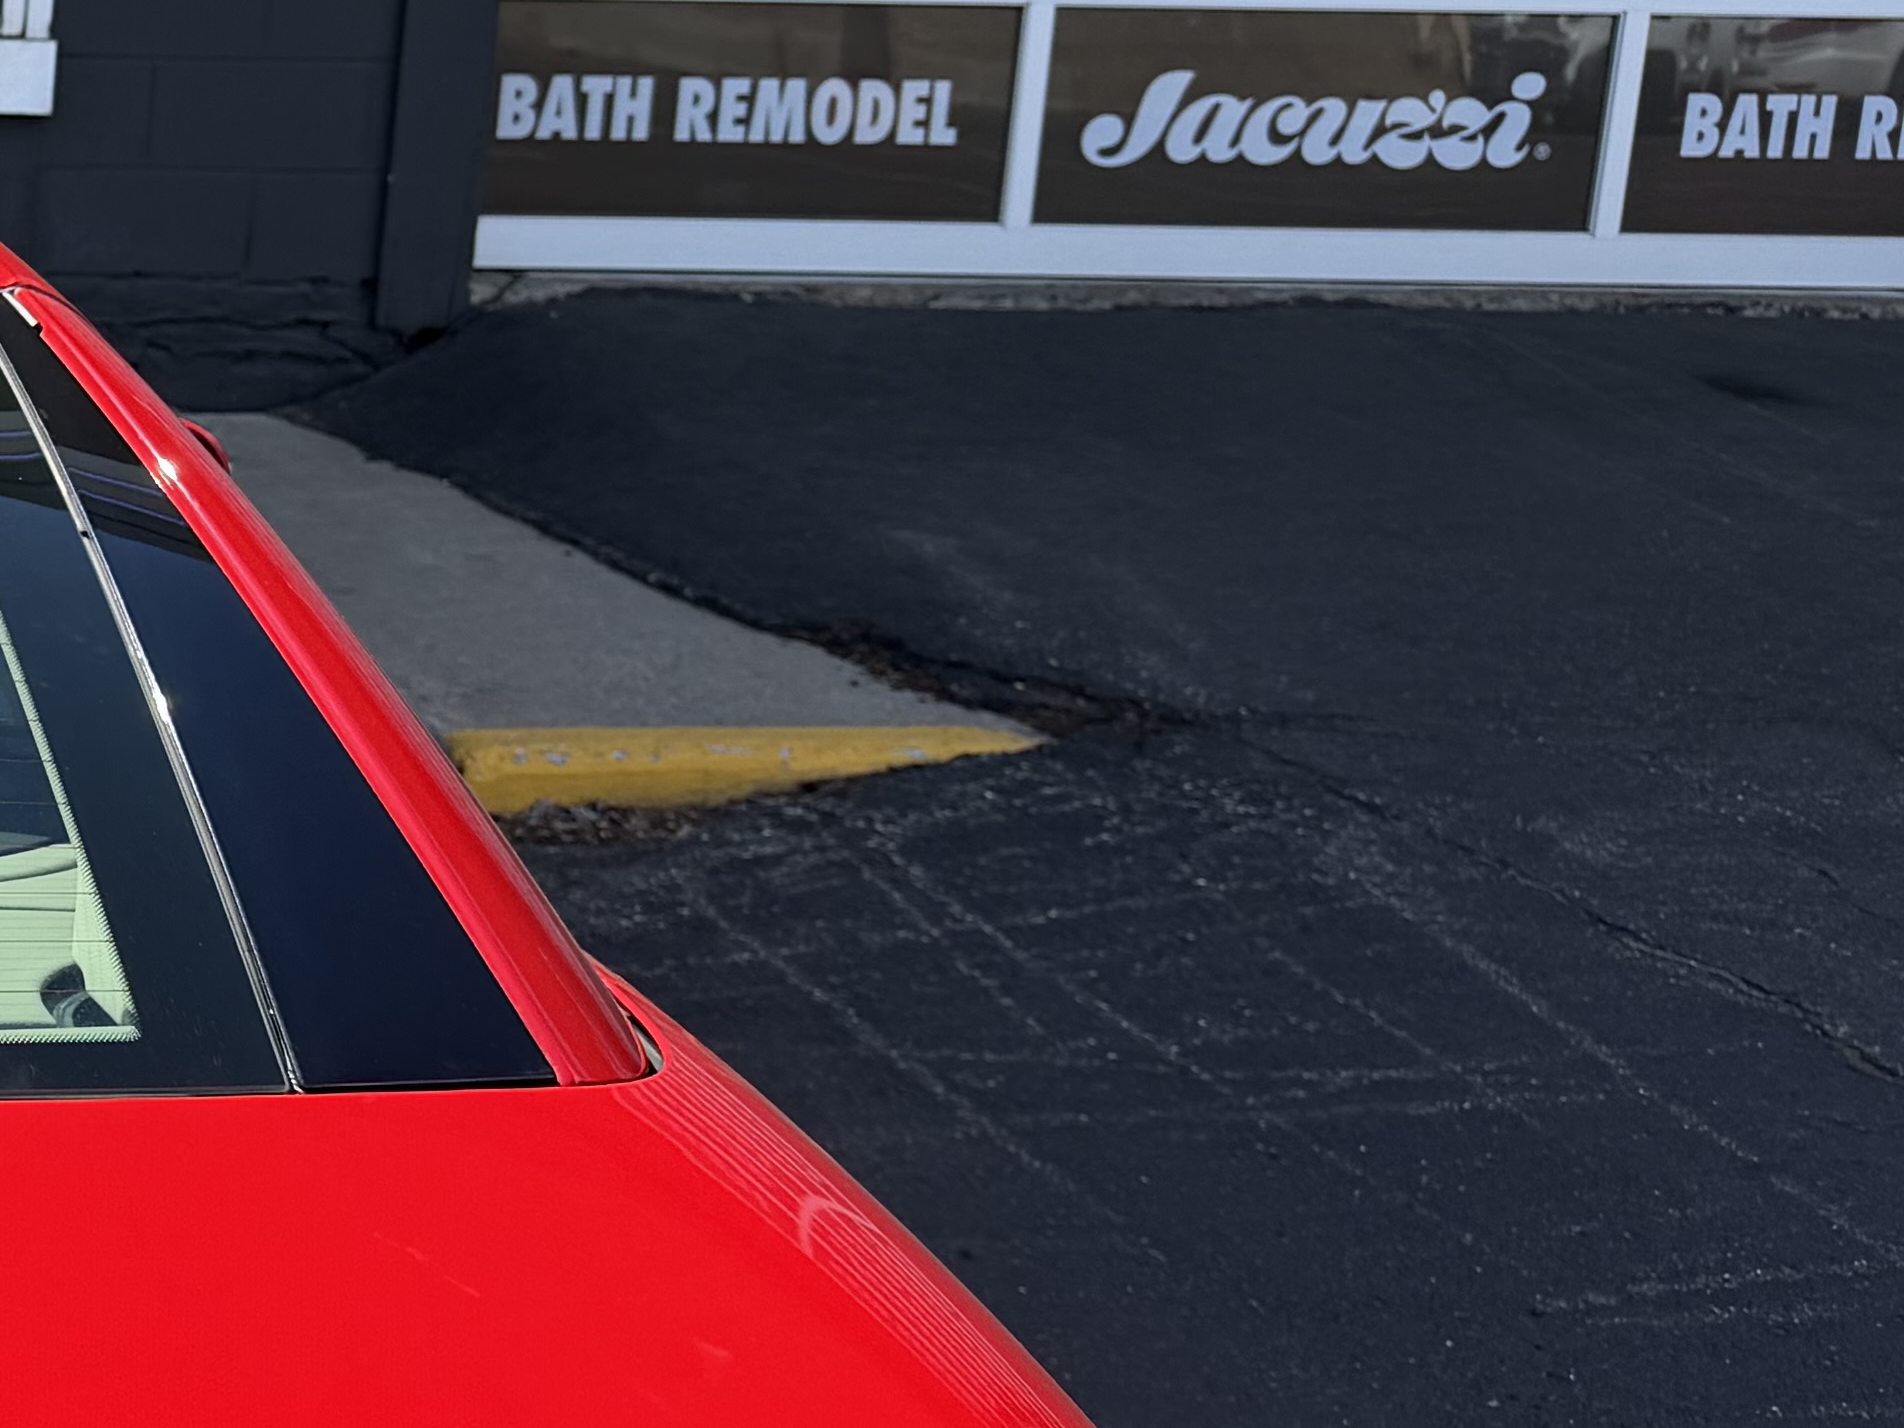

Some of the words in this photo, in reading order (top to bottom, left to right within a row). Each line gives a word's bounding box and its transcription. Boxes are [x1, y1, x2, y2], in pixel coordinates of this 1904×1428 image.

[495, 74, 655, 142] BATH
[674, 77, 957, 146] REMODEL
[1679, 92, 1839, 160] BATH
[1854, 94, 1904, 160] R
